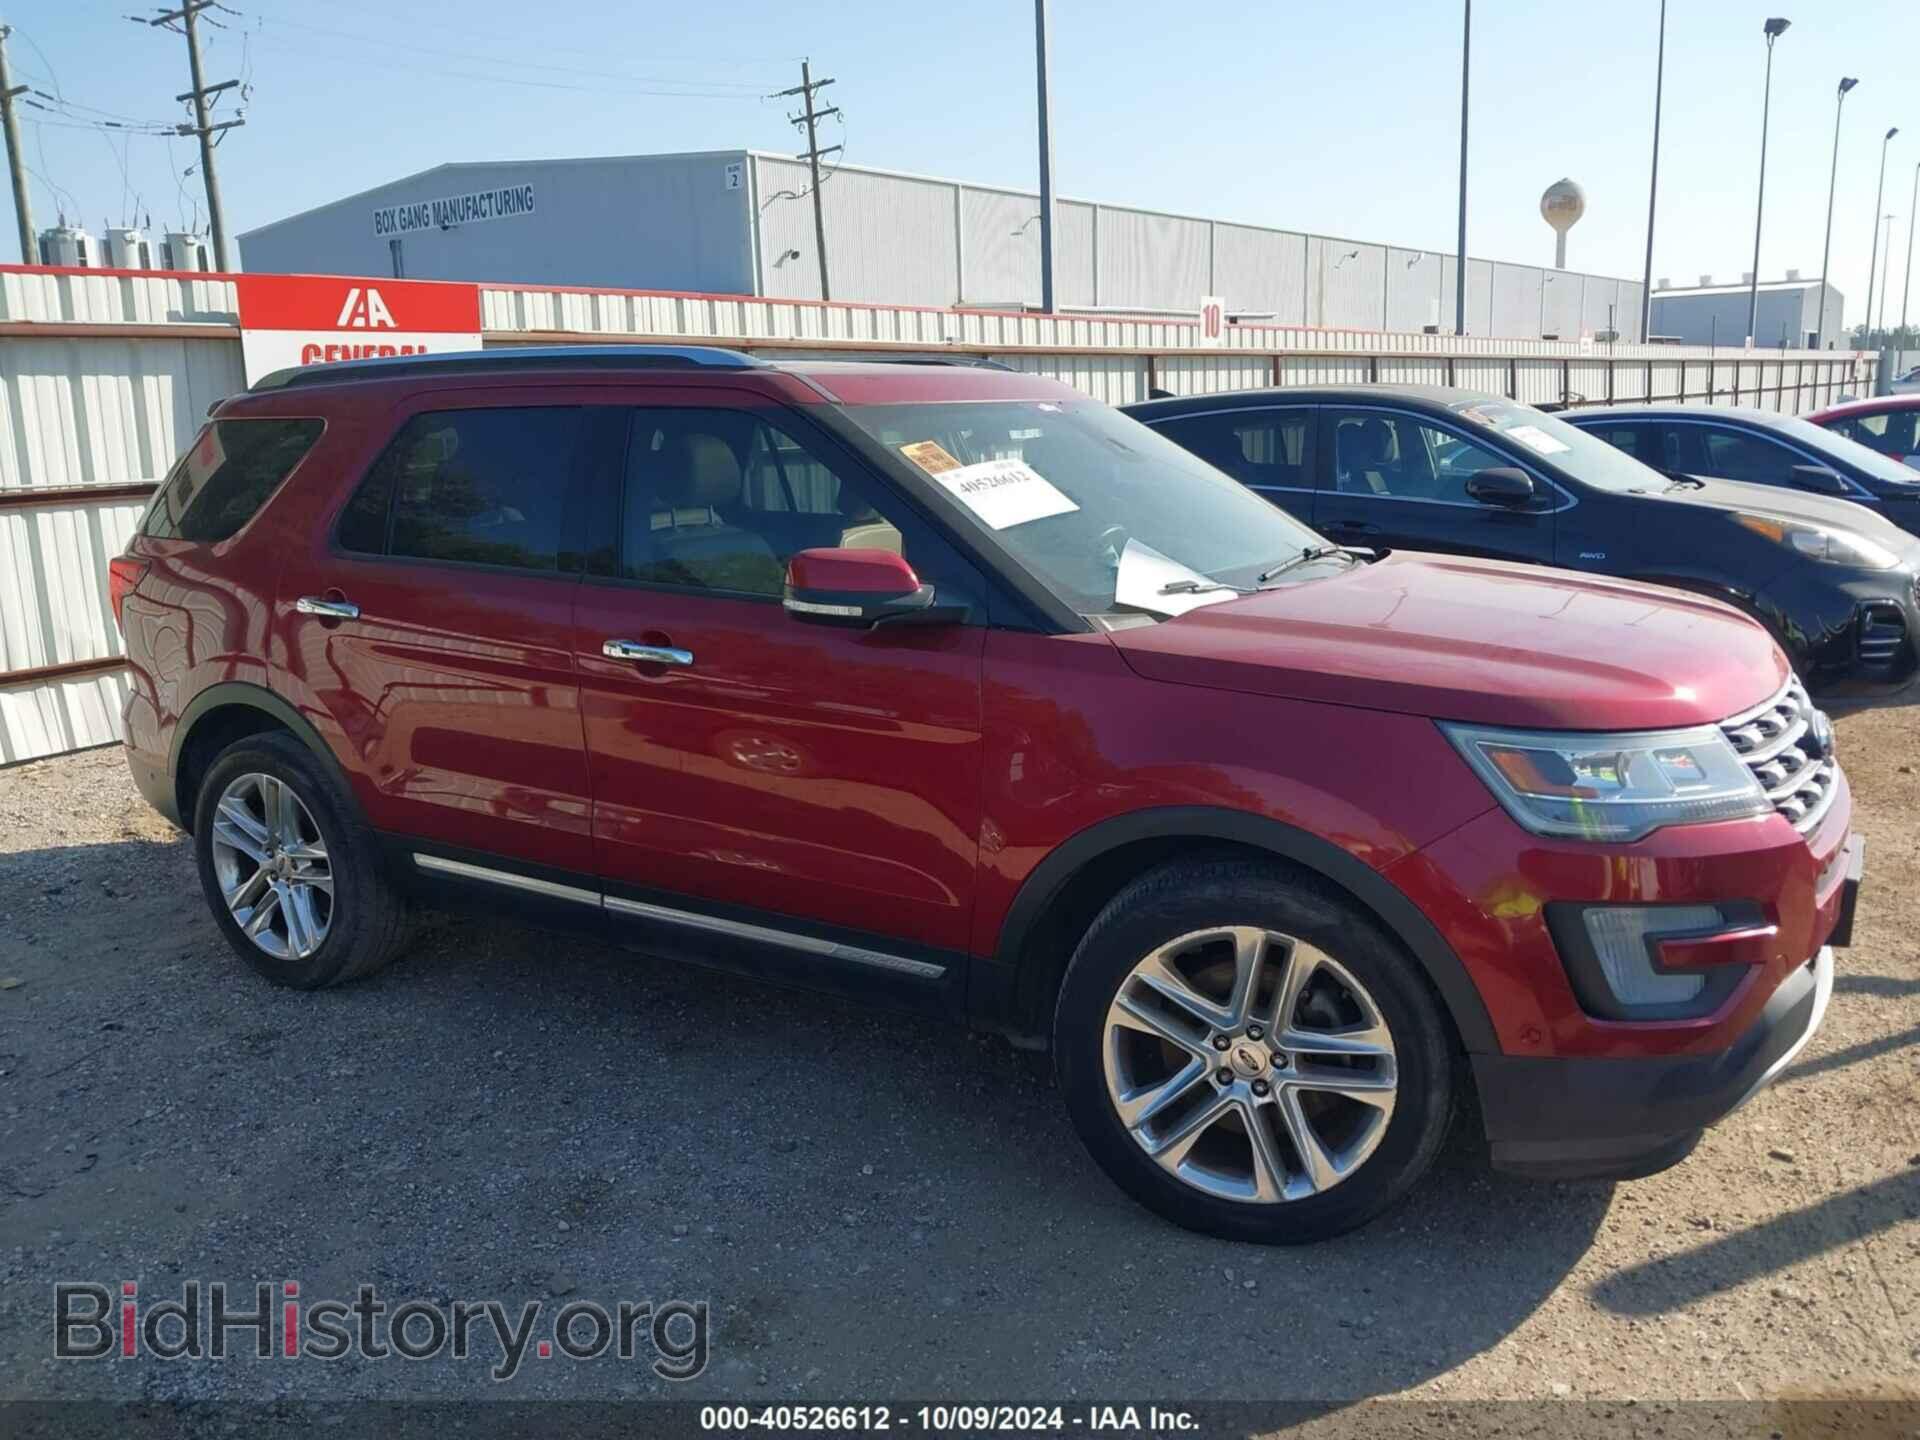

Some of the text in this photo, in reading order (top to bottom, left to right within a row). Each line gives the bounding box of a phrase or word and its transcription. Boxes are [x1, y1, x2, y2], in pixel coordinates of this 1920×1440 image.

[732, 174, 738, 187] 2
[375, 186, 534, 235] BOX GANG MANUFACTURING
[1203, 304, 1220, 338] 10
